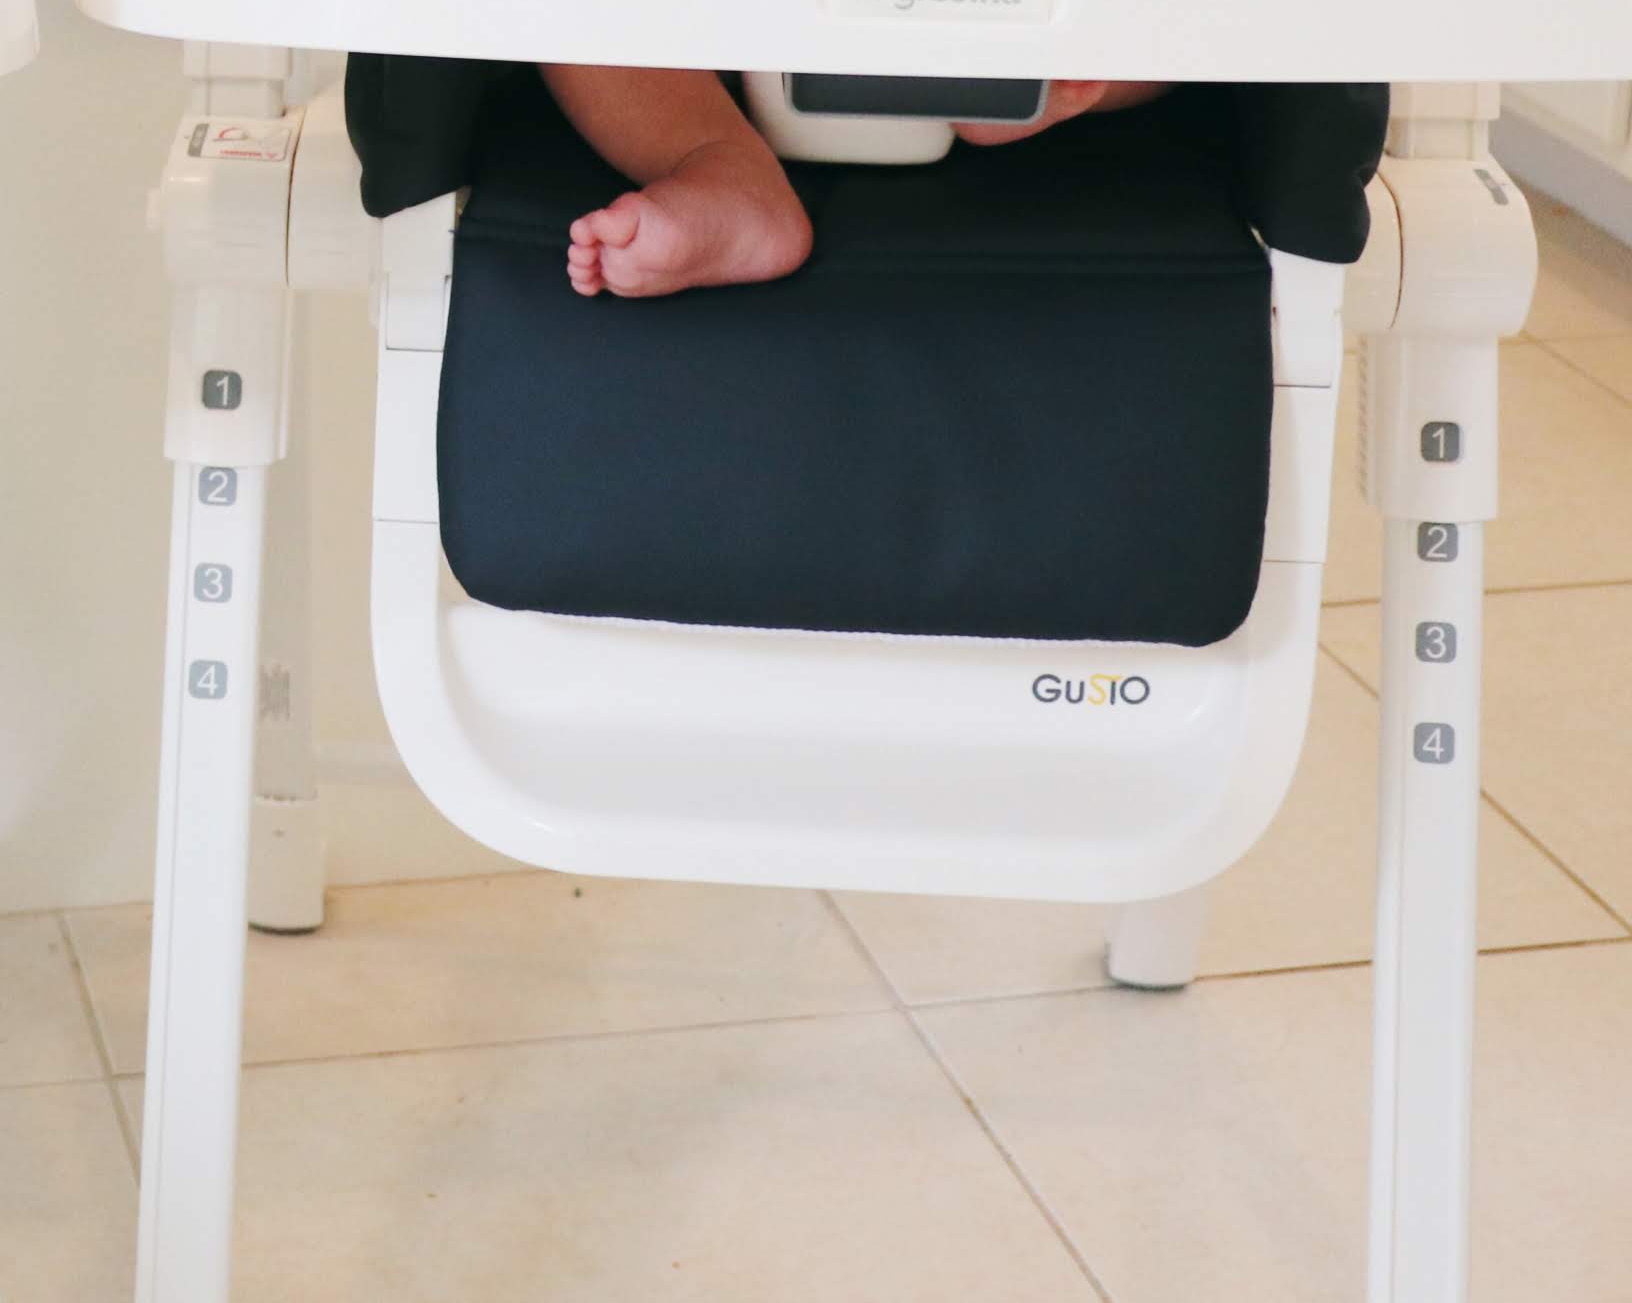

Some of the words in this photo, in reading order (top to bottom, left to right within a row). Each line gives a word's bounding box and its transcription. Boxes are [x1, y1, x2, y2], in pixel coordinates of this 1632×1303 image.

[206, 471, 229, 503] 2
[1426, 526, 1448, 559] 2
[202, 568, 224, 599] 3
[1425, 626, 1447, 659] 3
[197, 664, 219, 696] 4
[1422, 728, 1445, 761] 4
